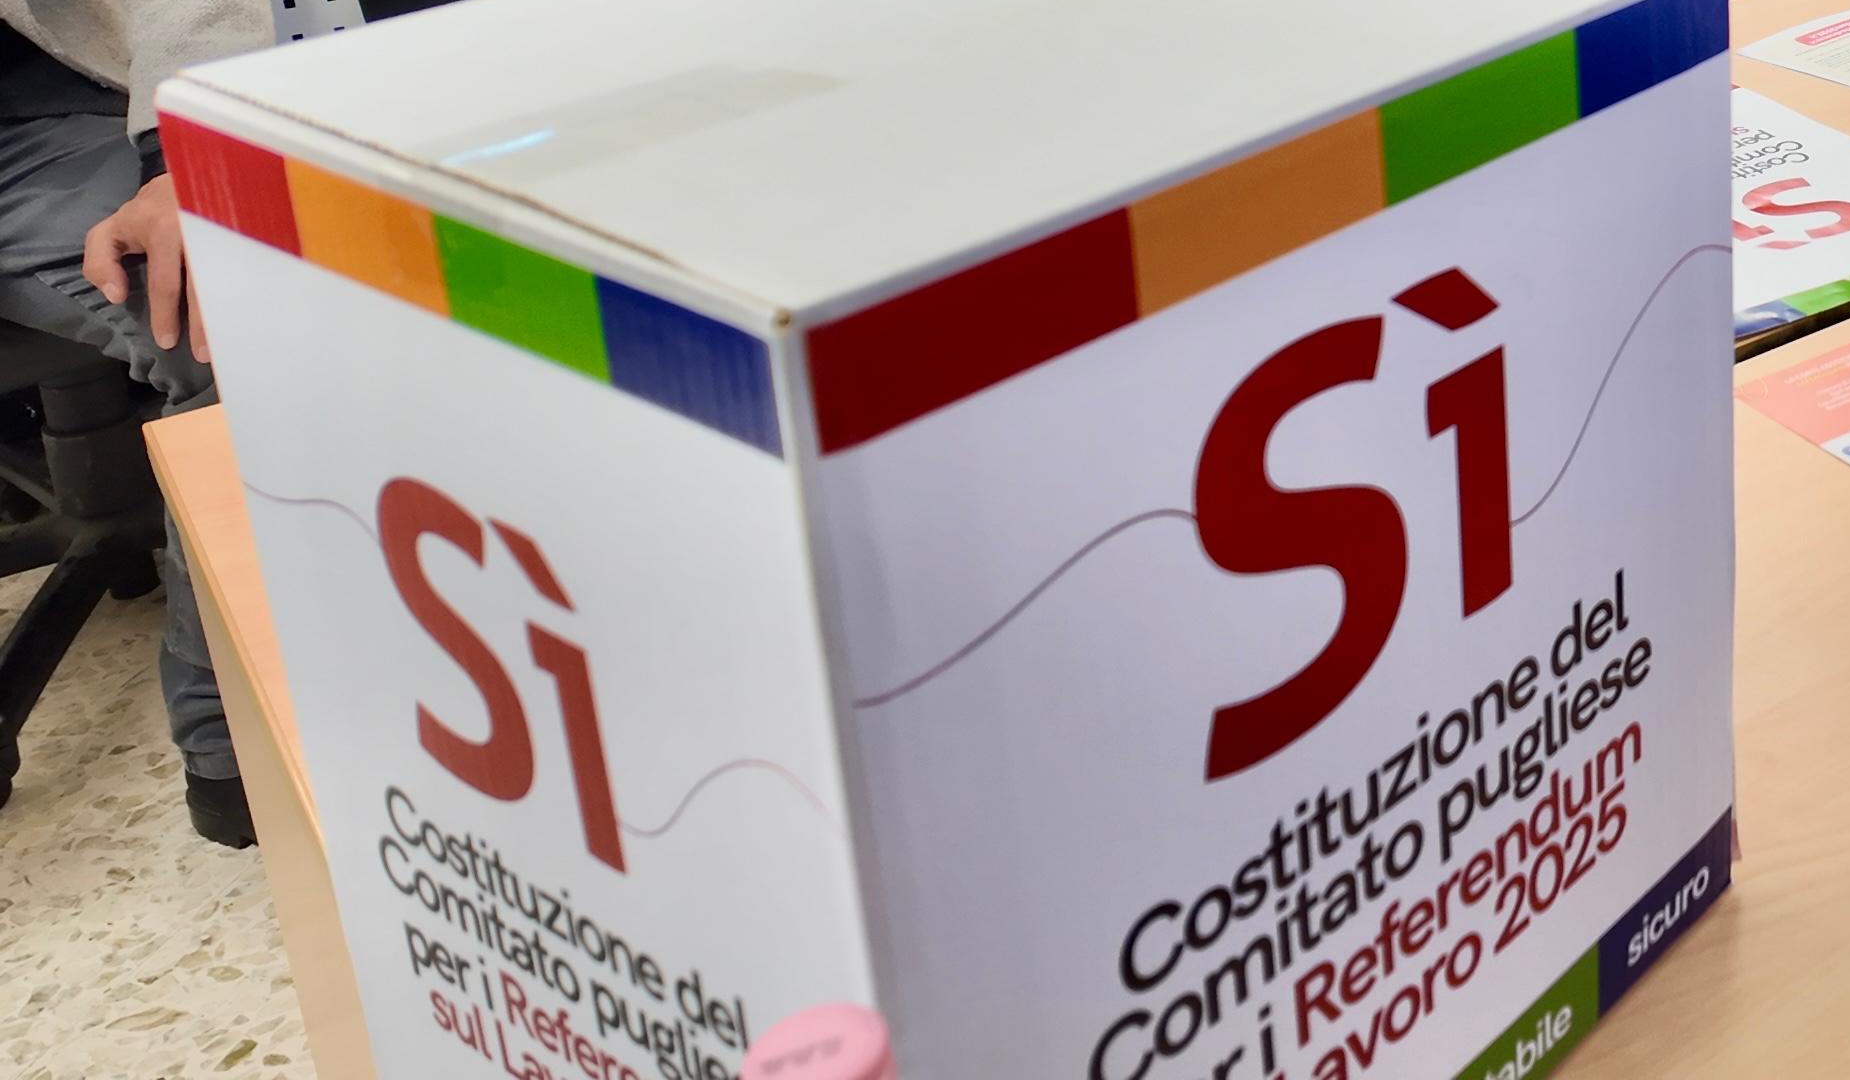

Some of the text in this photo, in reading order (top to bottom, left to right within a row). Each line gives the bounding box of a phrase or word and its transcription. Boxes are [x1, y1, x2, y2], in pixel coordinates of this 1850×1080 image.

[1192, 266, 1514, 783] Sì
[376, 475, 628, 874] Sì
[1119, 569, 1630, 993] Costituzione del
[379, 835, 582, 1003] Comitato
[385, 786, 749, 1052] Costituzione del
[404, 921, 471, 996] per
[477, 958, 494, 1011] i
[1088, 637, 1654, 1080] Comitato pugliese
[1275, 781, 1629, 1080] avoro 2025
[1293, 721, 1644, 1050] Referendum
[1626, 865, 1710, 968] sicuro
[429, 989, 494, 1062] sul
